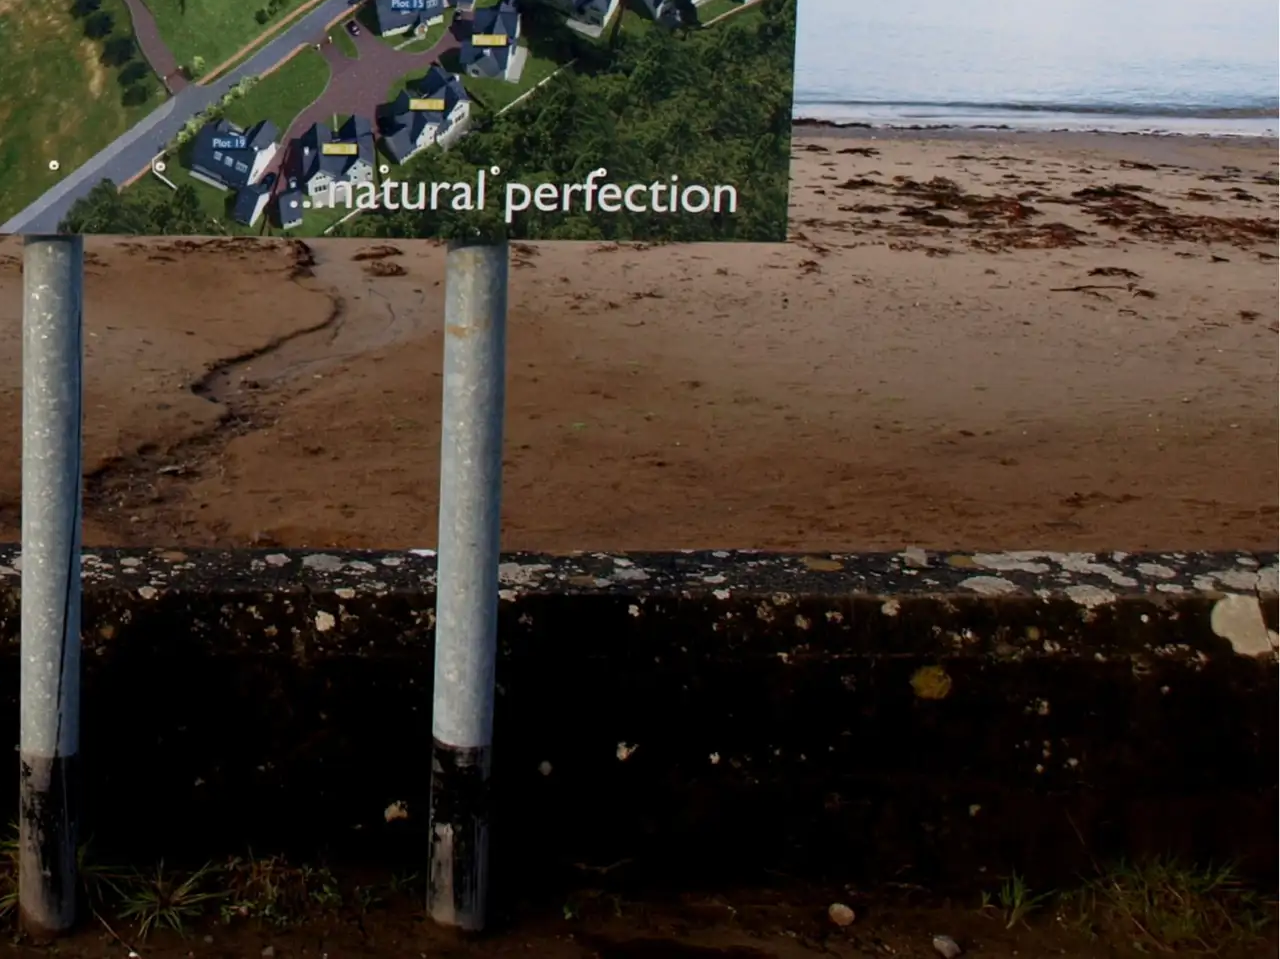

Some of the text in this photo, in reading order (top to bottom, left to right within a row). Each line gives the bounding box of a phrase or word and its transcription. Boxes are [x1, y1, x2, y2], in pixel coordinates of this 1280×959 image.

[212, 138, 231, 148] Plot
[289, 169, 737, 224] ...natural perfection
